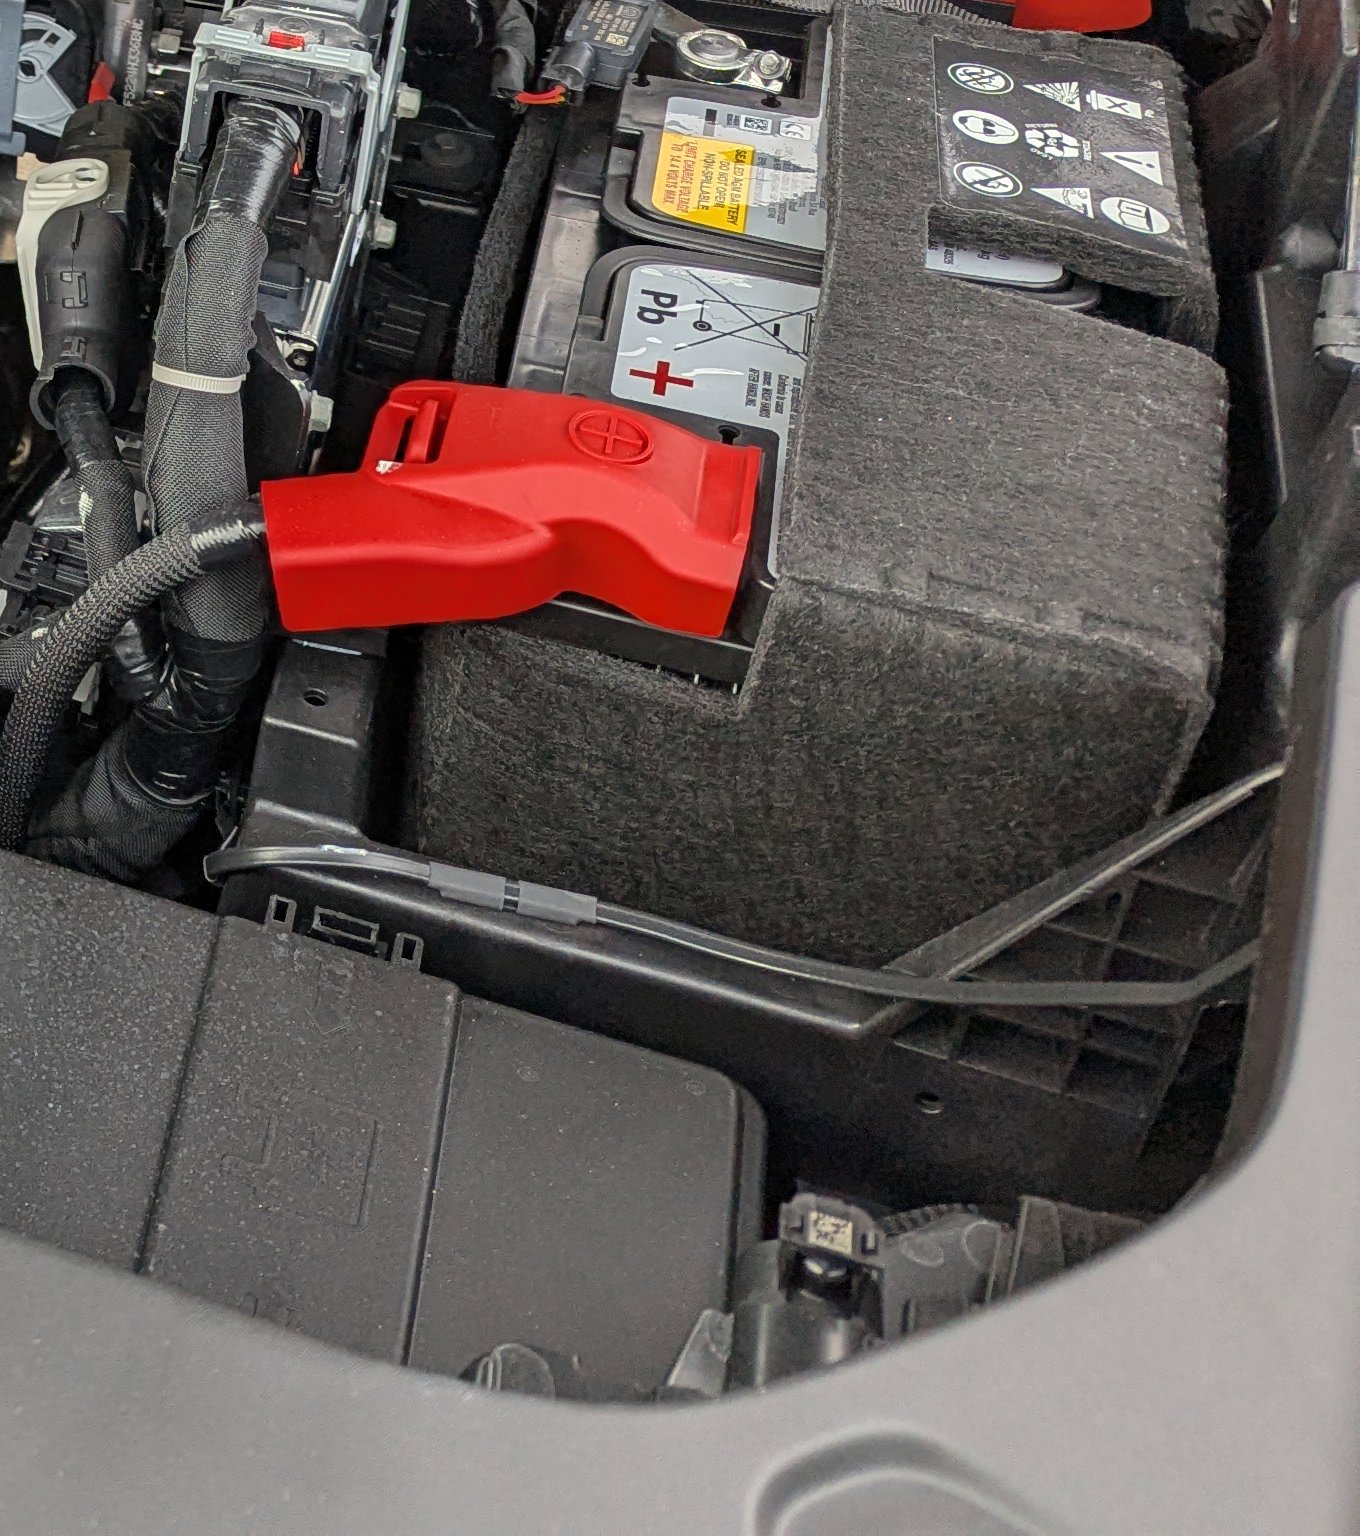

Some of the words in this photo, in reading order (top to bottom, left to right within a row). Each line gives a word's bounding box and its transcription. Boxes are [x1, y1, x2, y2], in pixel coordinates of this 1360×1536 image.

[734, 149, 748, 176] SEALED
[697, 152, 716, 211] NON-SPILLABLE
[726, 192, 741, 226] BATTERY
[636, 288, 678, 325] Pb
